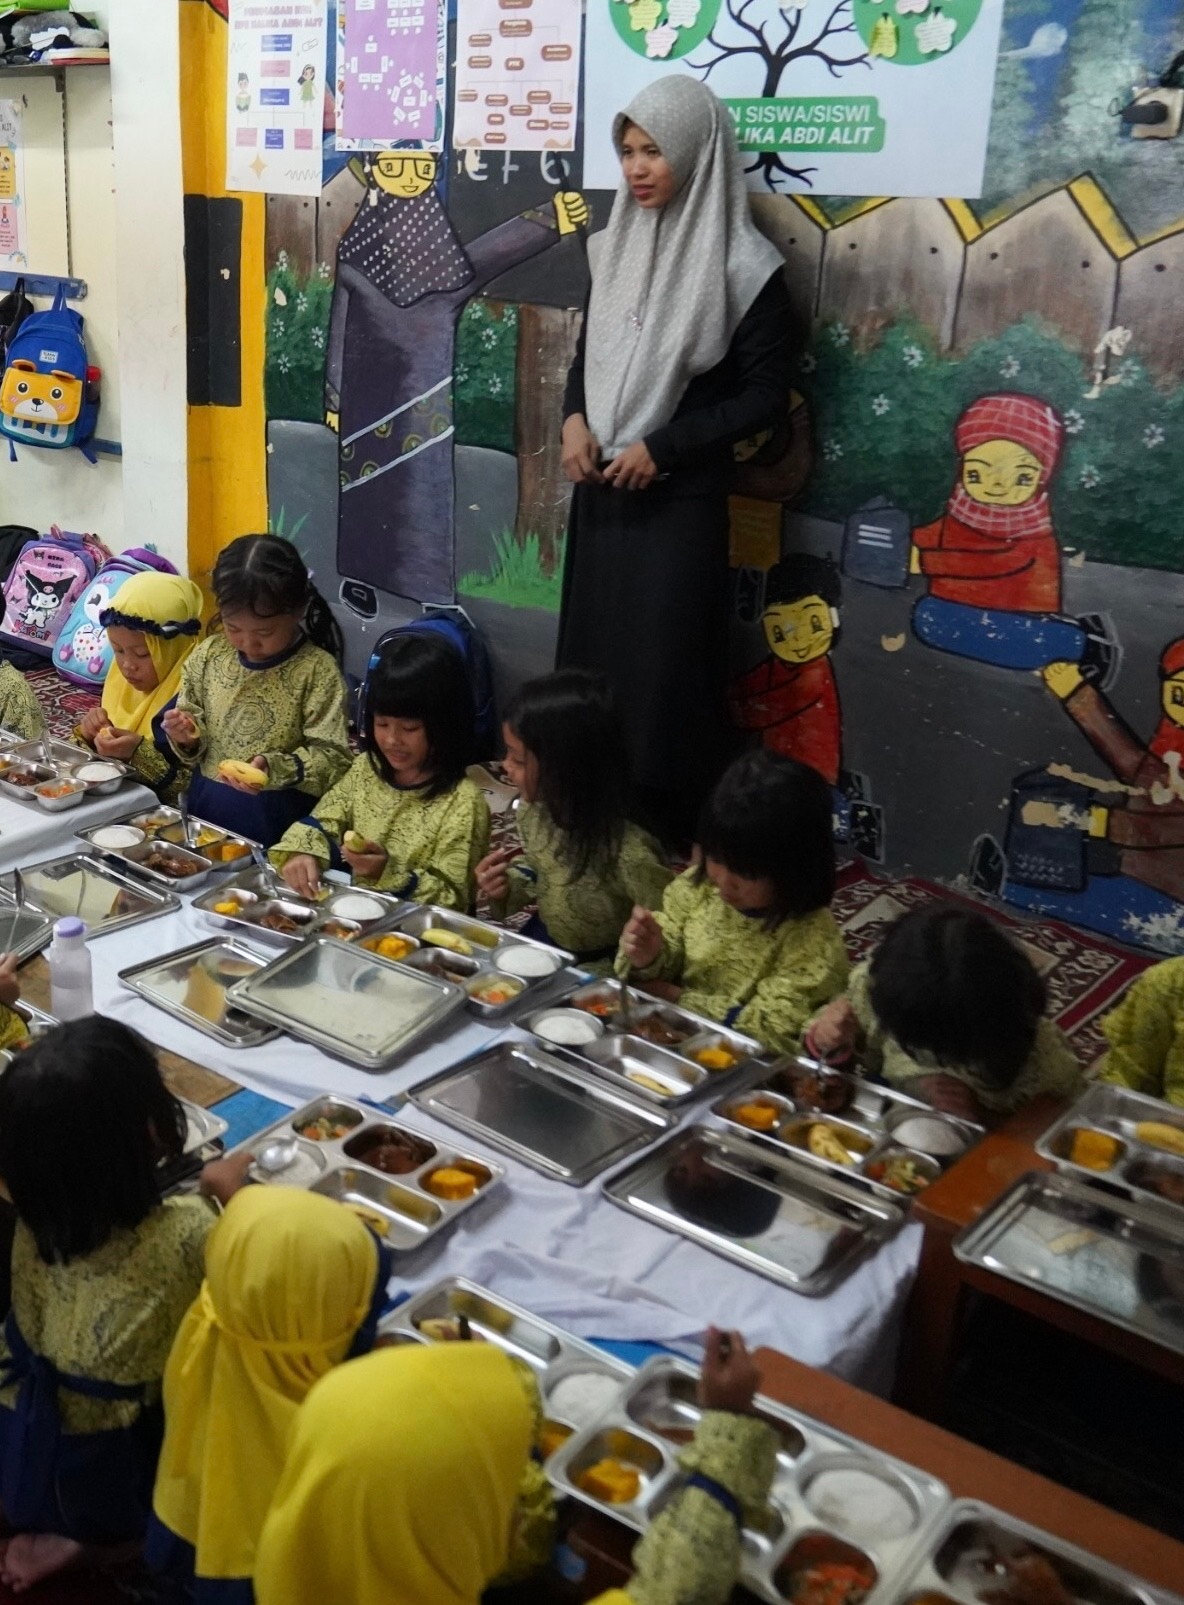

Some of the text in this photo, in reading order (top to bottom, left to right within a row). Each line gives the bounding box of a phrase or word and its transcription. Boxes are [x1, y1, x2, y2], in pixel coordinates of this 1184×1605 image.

[745, 104, 870, 123] SISWA/SISWI
[734, 126, 875, 144] LIKA ABDI ALIT
